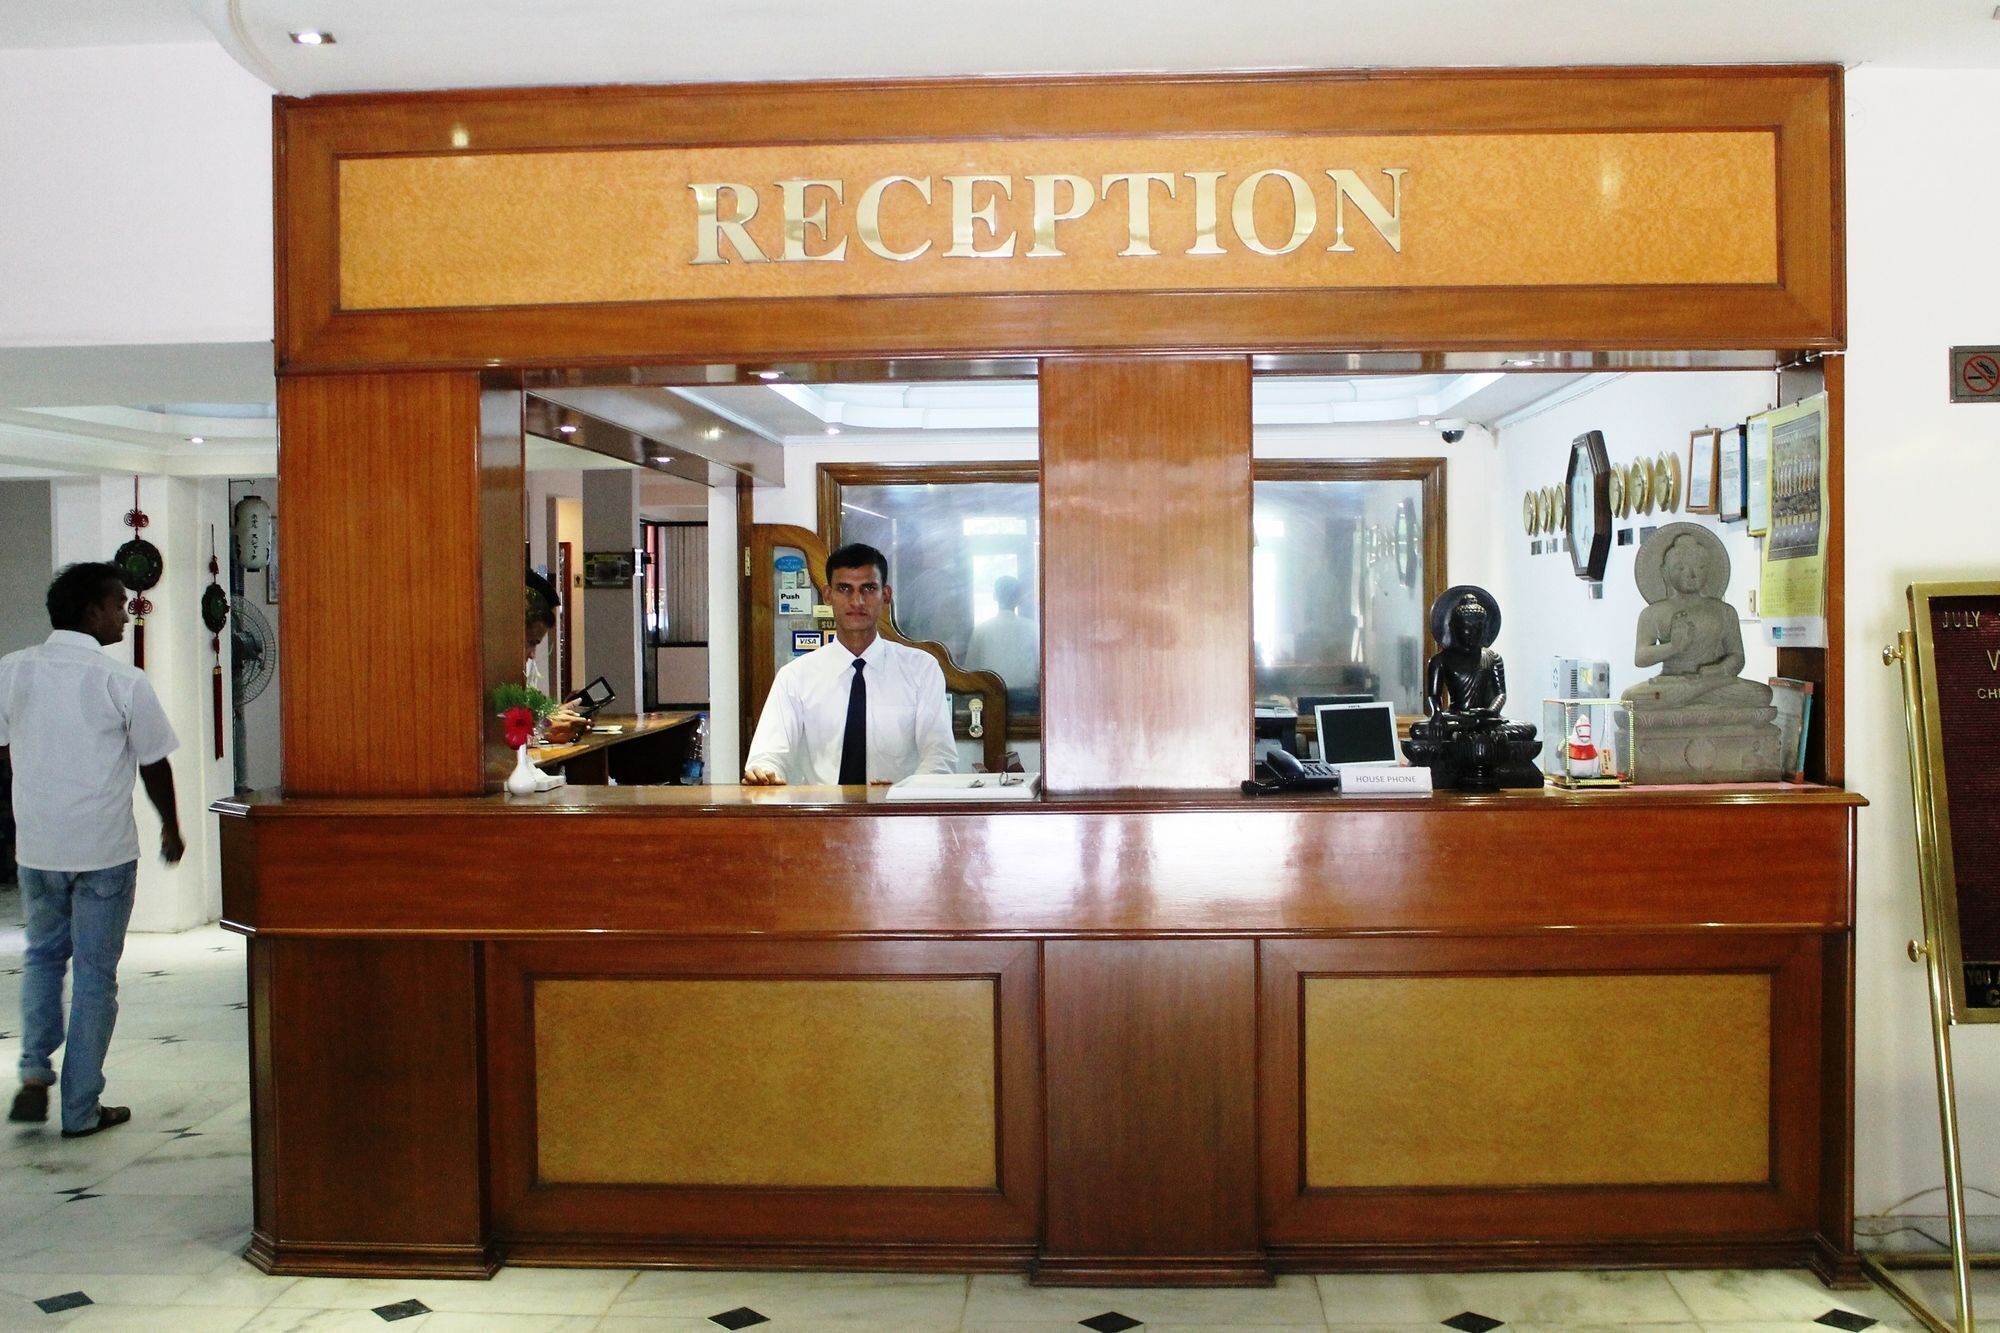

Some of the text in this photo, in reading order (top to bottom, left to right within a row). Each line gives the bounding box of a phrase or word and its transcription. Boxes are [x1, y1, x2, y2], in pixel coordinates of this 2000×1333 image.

[687, 167, 1409, 265] RECEPTION
[1942, 611, 1980, 628] JULY
[1355, 775, 1417, 783] HOUSE PHONE
